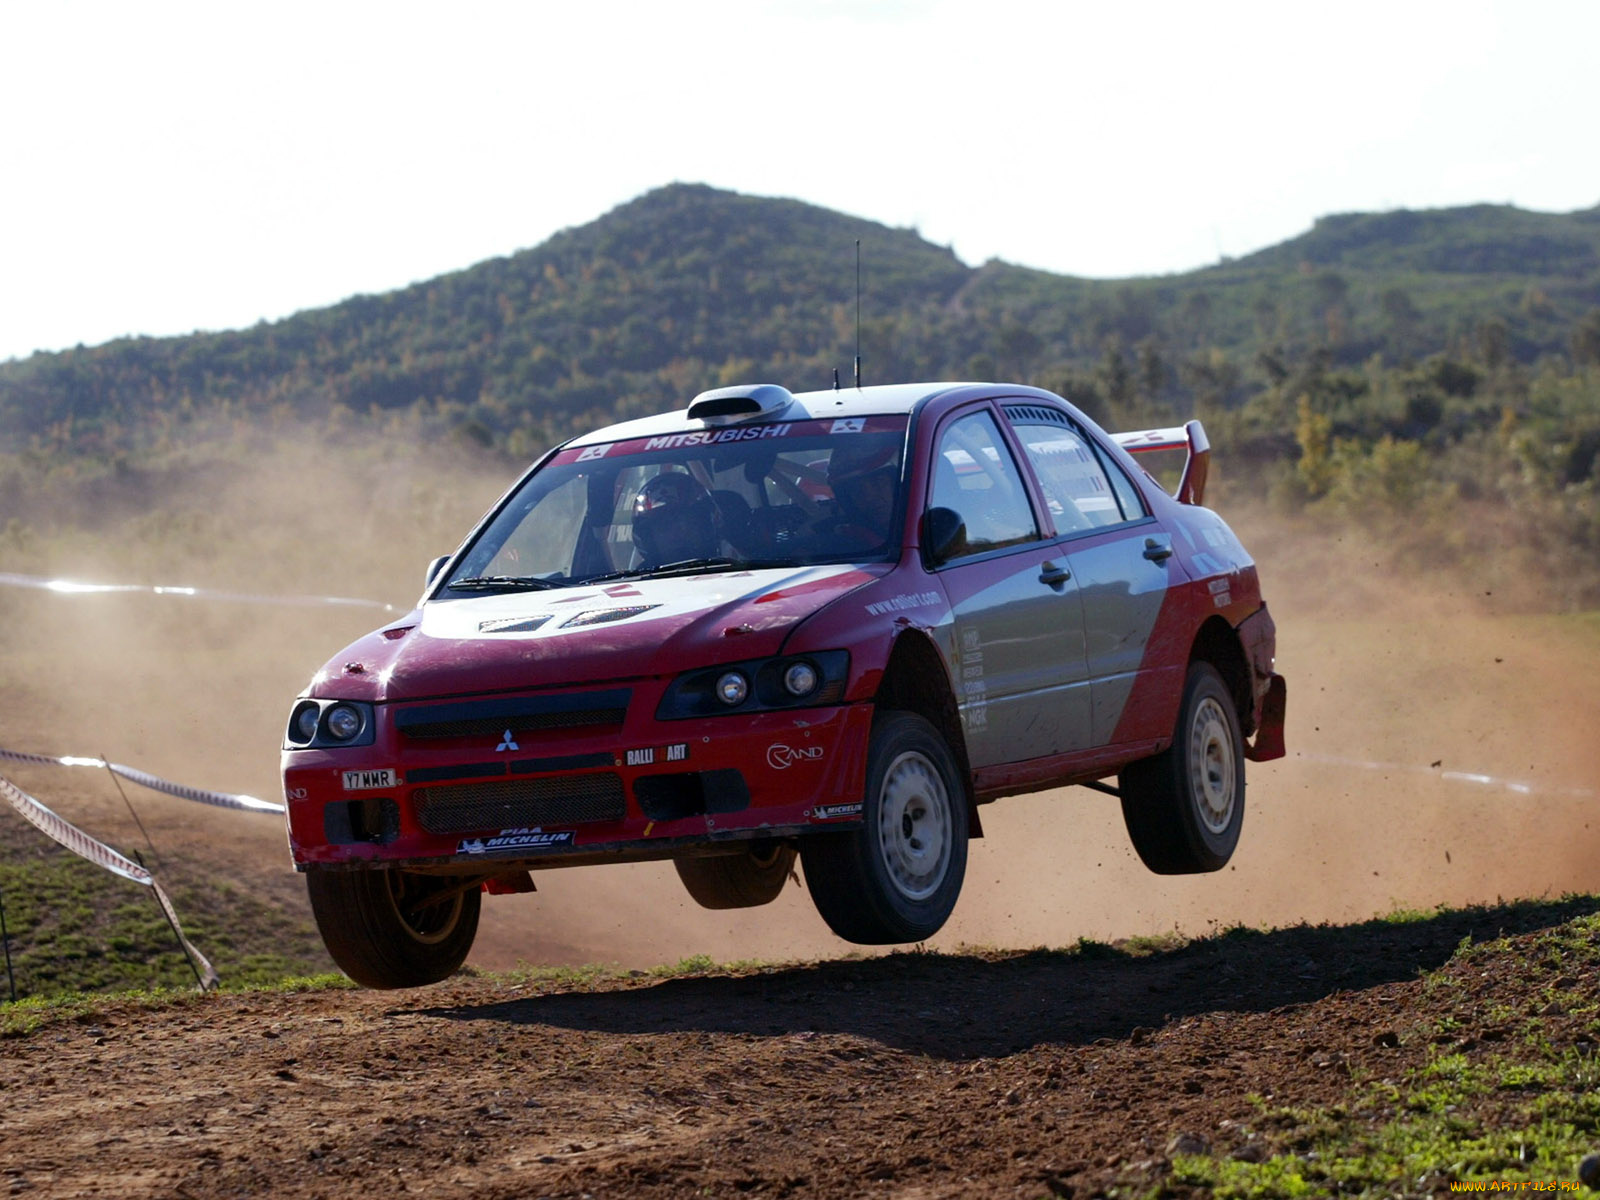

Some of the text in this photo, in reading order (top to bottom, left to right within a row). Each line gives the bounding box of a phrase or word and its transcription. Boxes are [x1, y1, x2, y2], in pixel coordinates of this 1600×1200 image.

[644, 424, 791, 450] MITSUBISHI
[627, 744, 687, 766] RALLI ART
[346, 772, 359, 788] Y7
[827, 804, 863, 814] MICHELIN
[486, 833, 570, 846] MICHELIN
